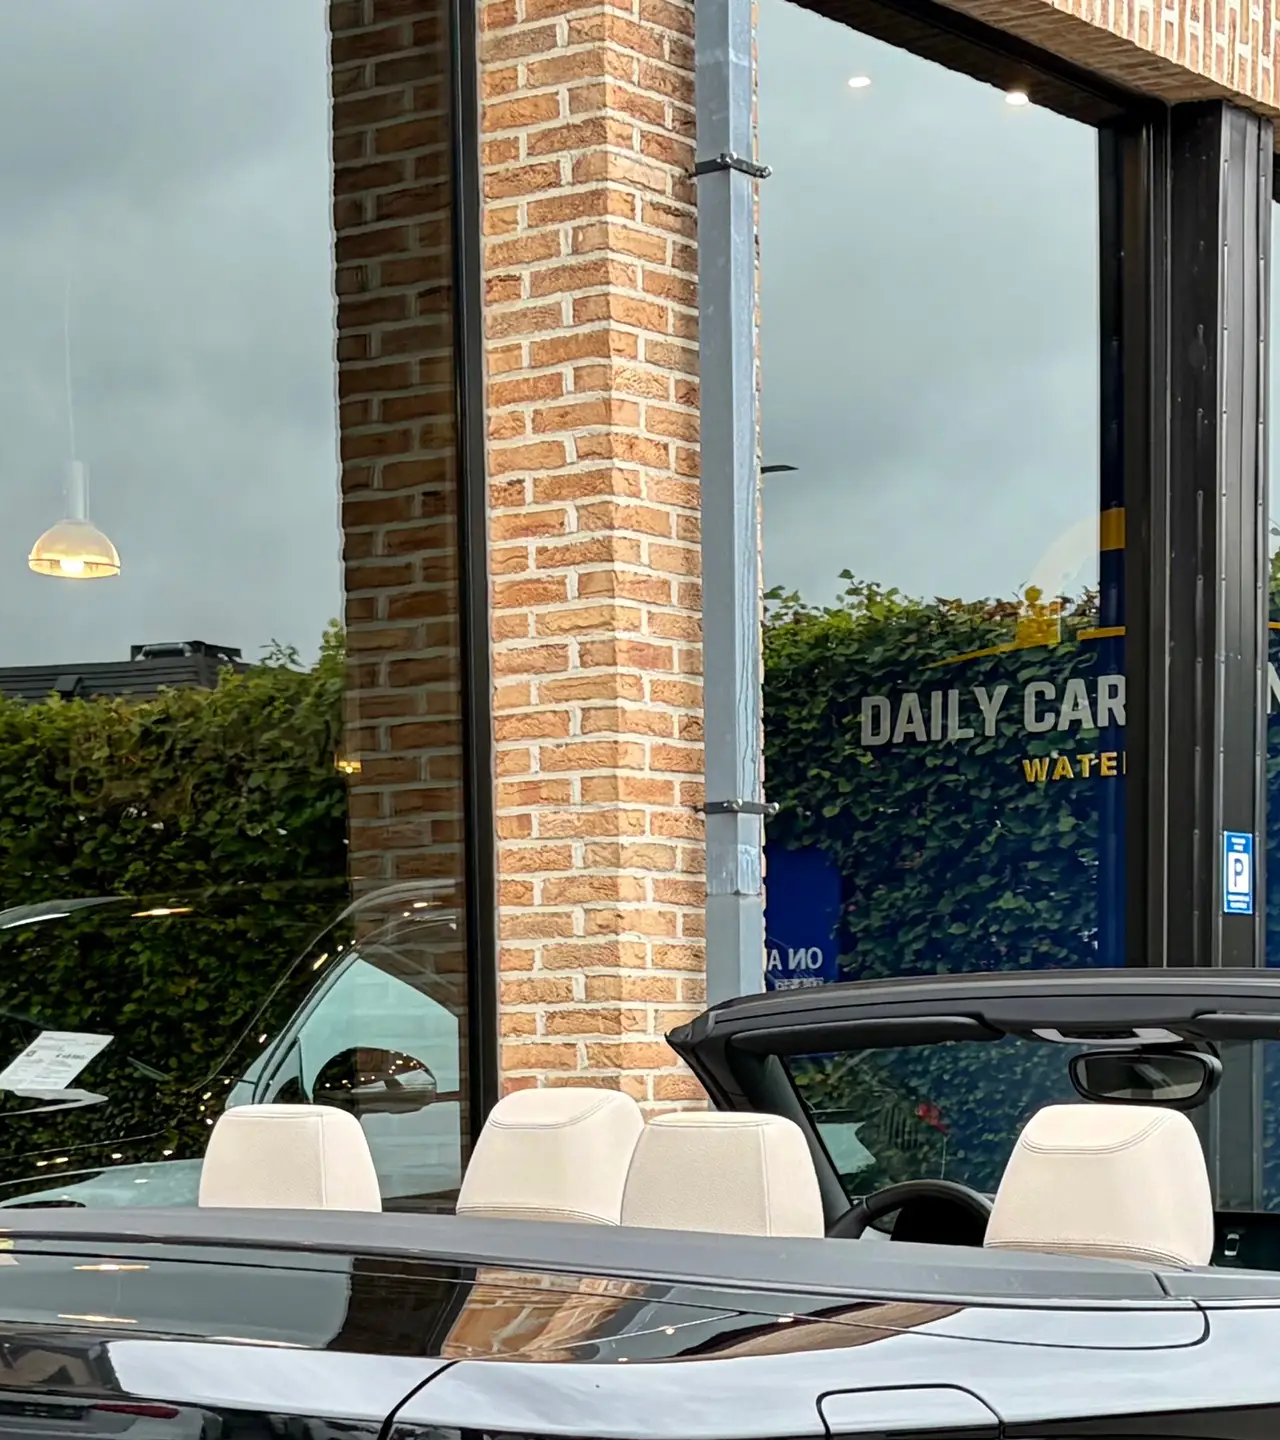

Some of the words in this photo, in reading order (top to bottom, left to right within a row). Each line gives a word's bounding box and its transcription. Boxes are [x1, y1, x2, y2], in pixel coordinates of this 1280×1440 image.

[860, 684, 1010, 746] DAILY
[1024, 673, 1126, 733] CAR
[1022, 751, 1126, 783] WATE
